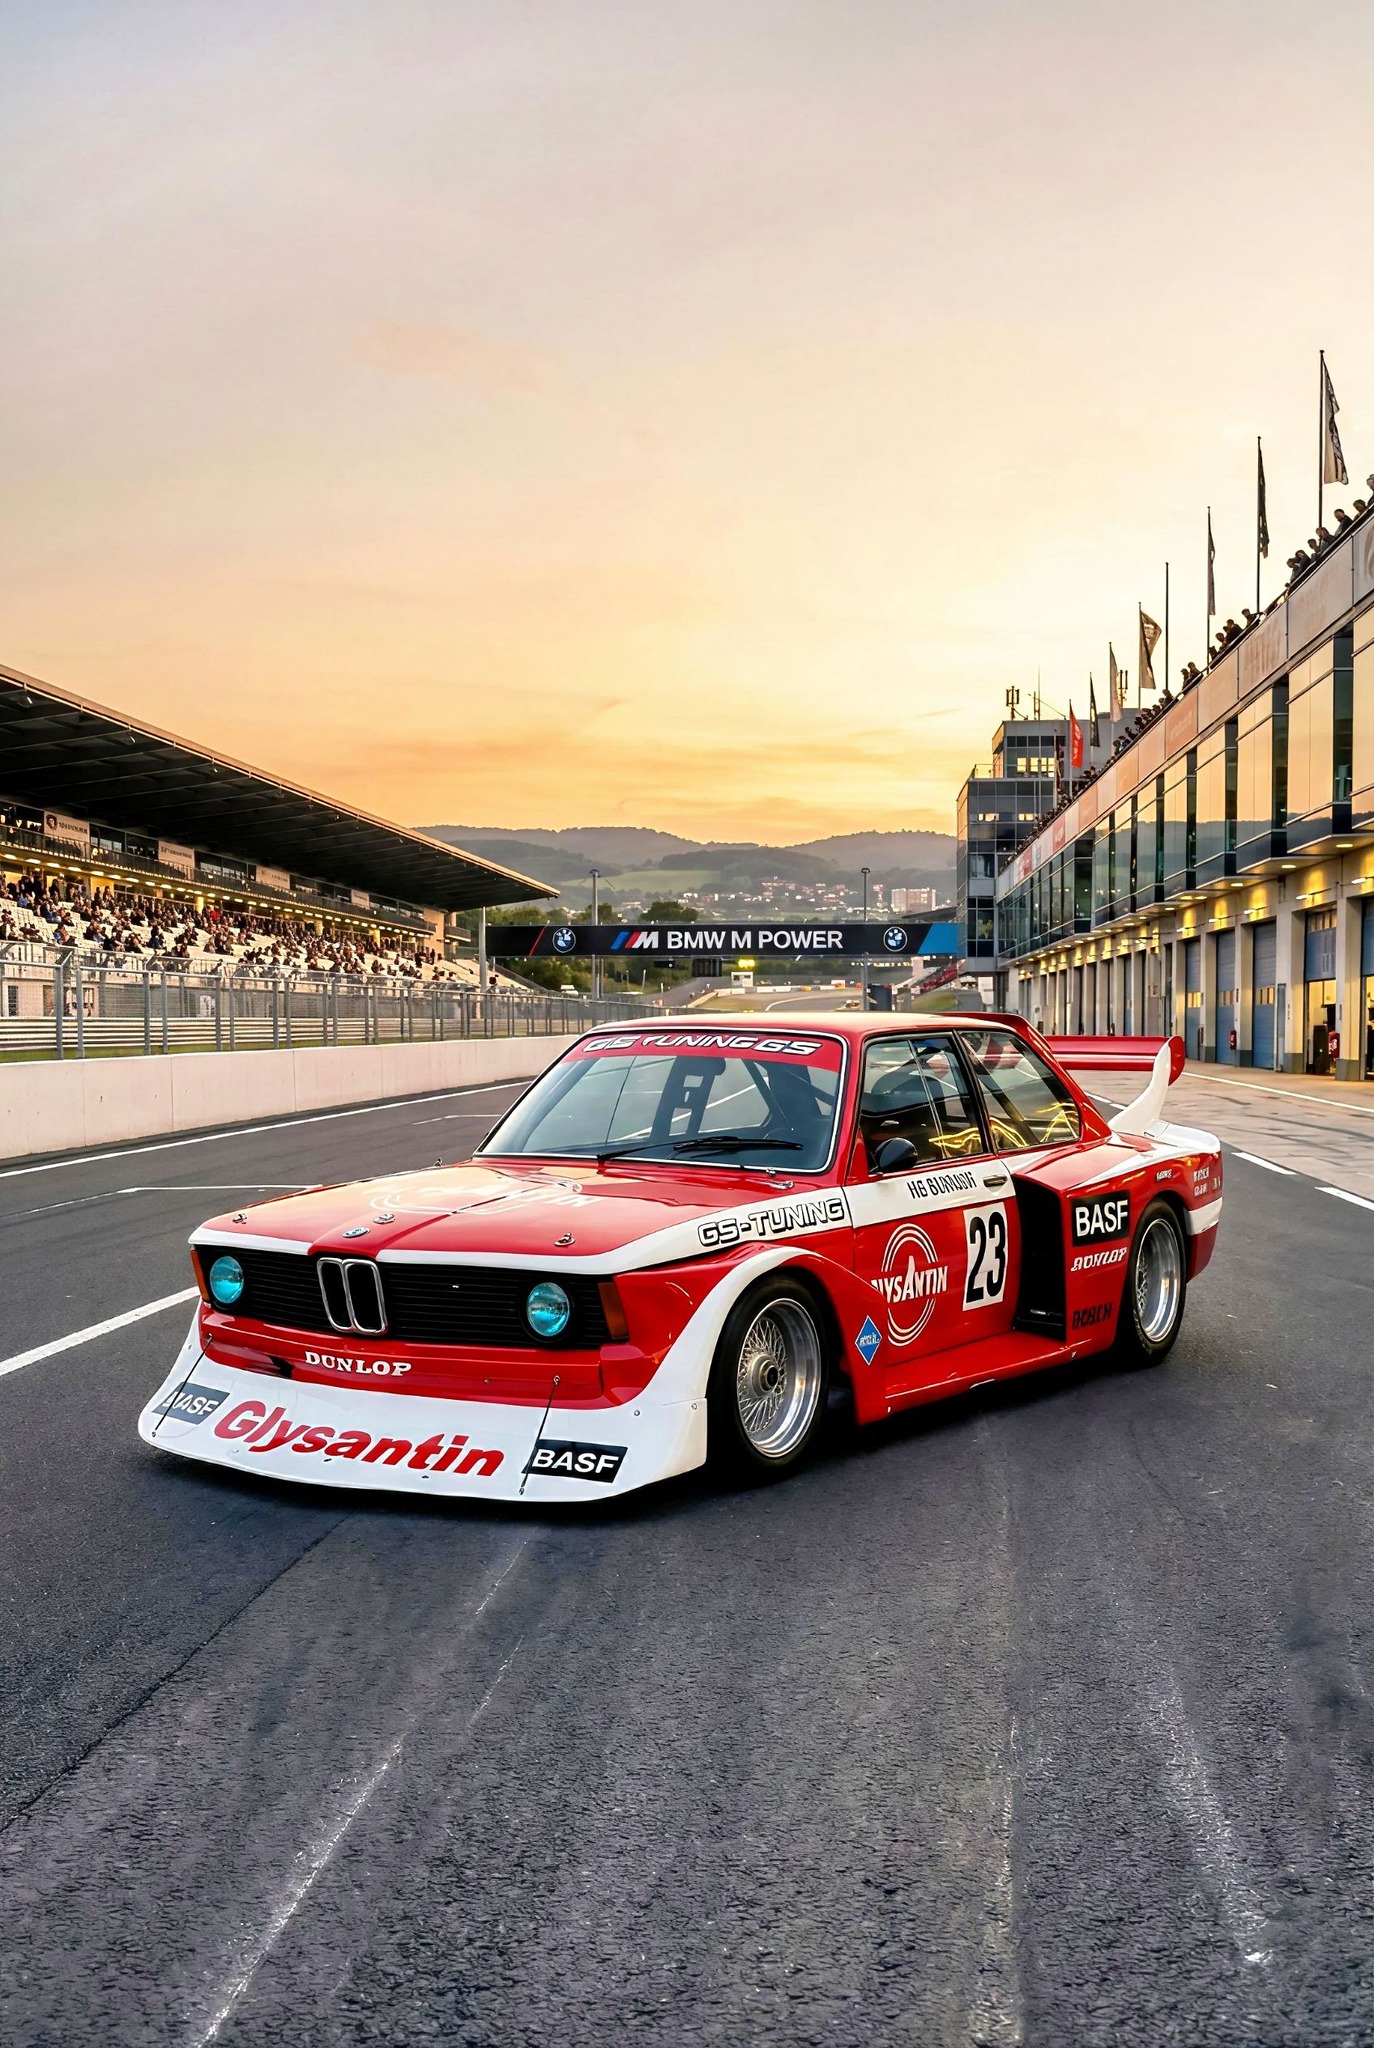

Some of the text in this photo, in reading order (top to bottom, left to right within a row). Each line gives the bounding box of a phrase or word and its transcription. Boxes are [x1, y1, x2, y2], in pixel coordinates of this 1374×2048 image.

[667, 931, 726, 949] BMW
[731, 931, 752, 949] M
[758, 931, 844, 949] POWER
[754, 1038, 823, 1056] GS
[697, 1198, 845, 1247] GS-TUNING
[1075, 1200, 1128, 1237] BASF
[964, 1211, 1006, 1304] 23
[305, 1351, 412, 1377] DUNLOP
[214, 1400, 505, 1477] Glysantin
[531, 1448, 619, 1474] BASF
